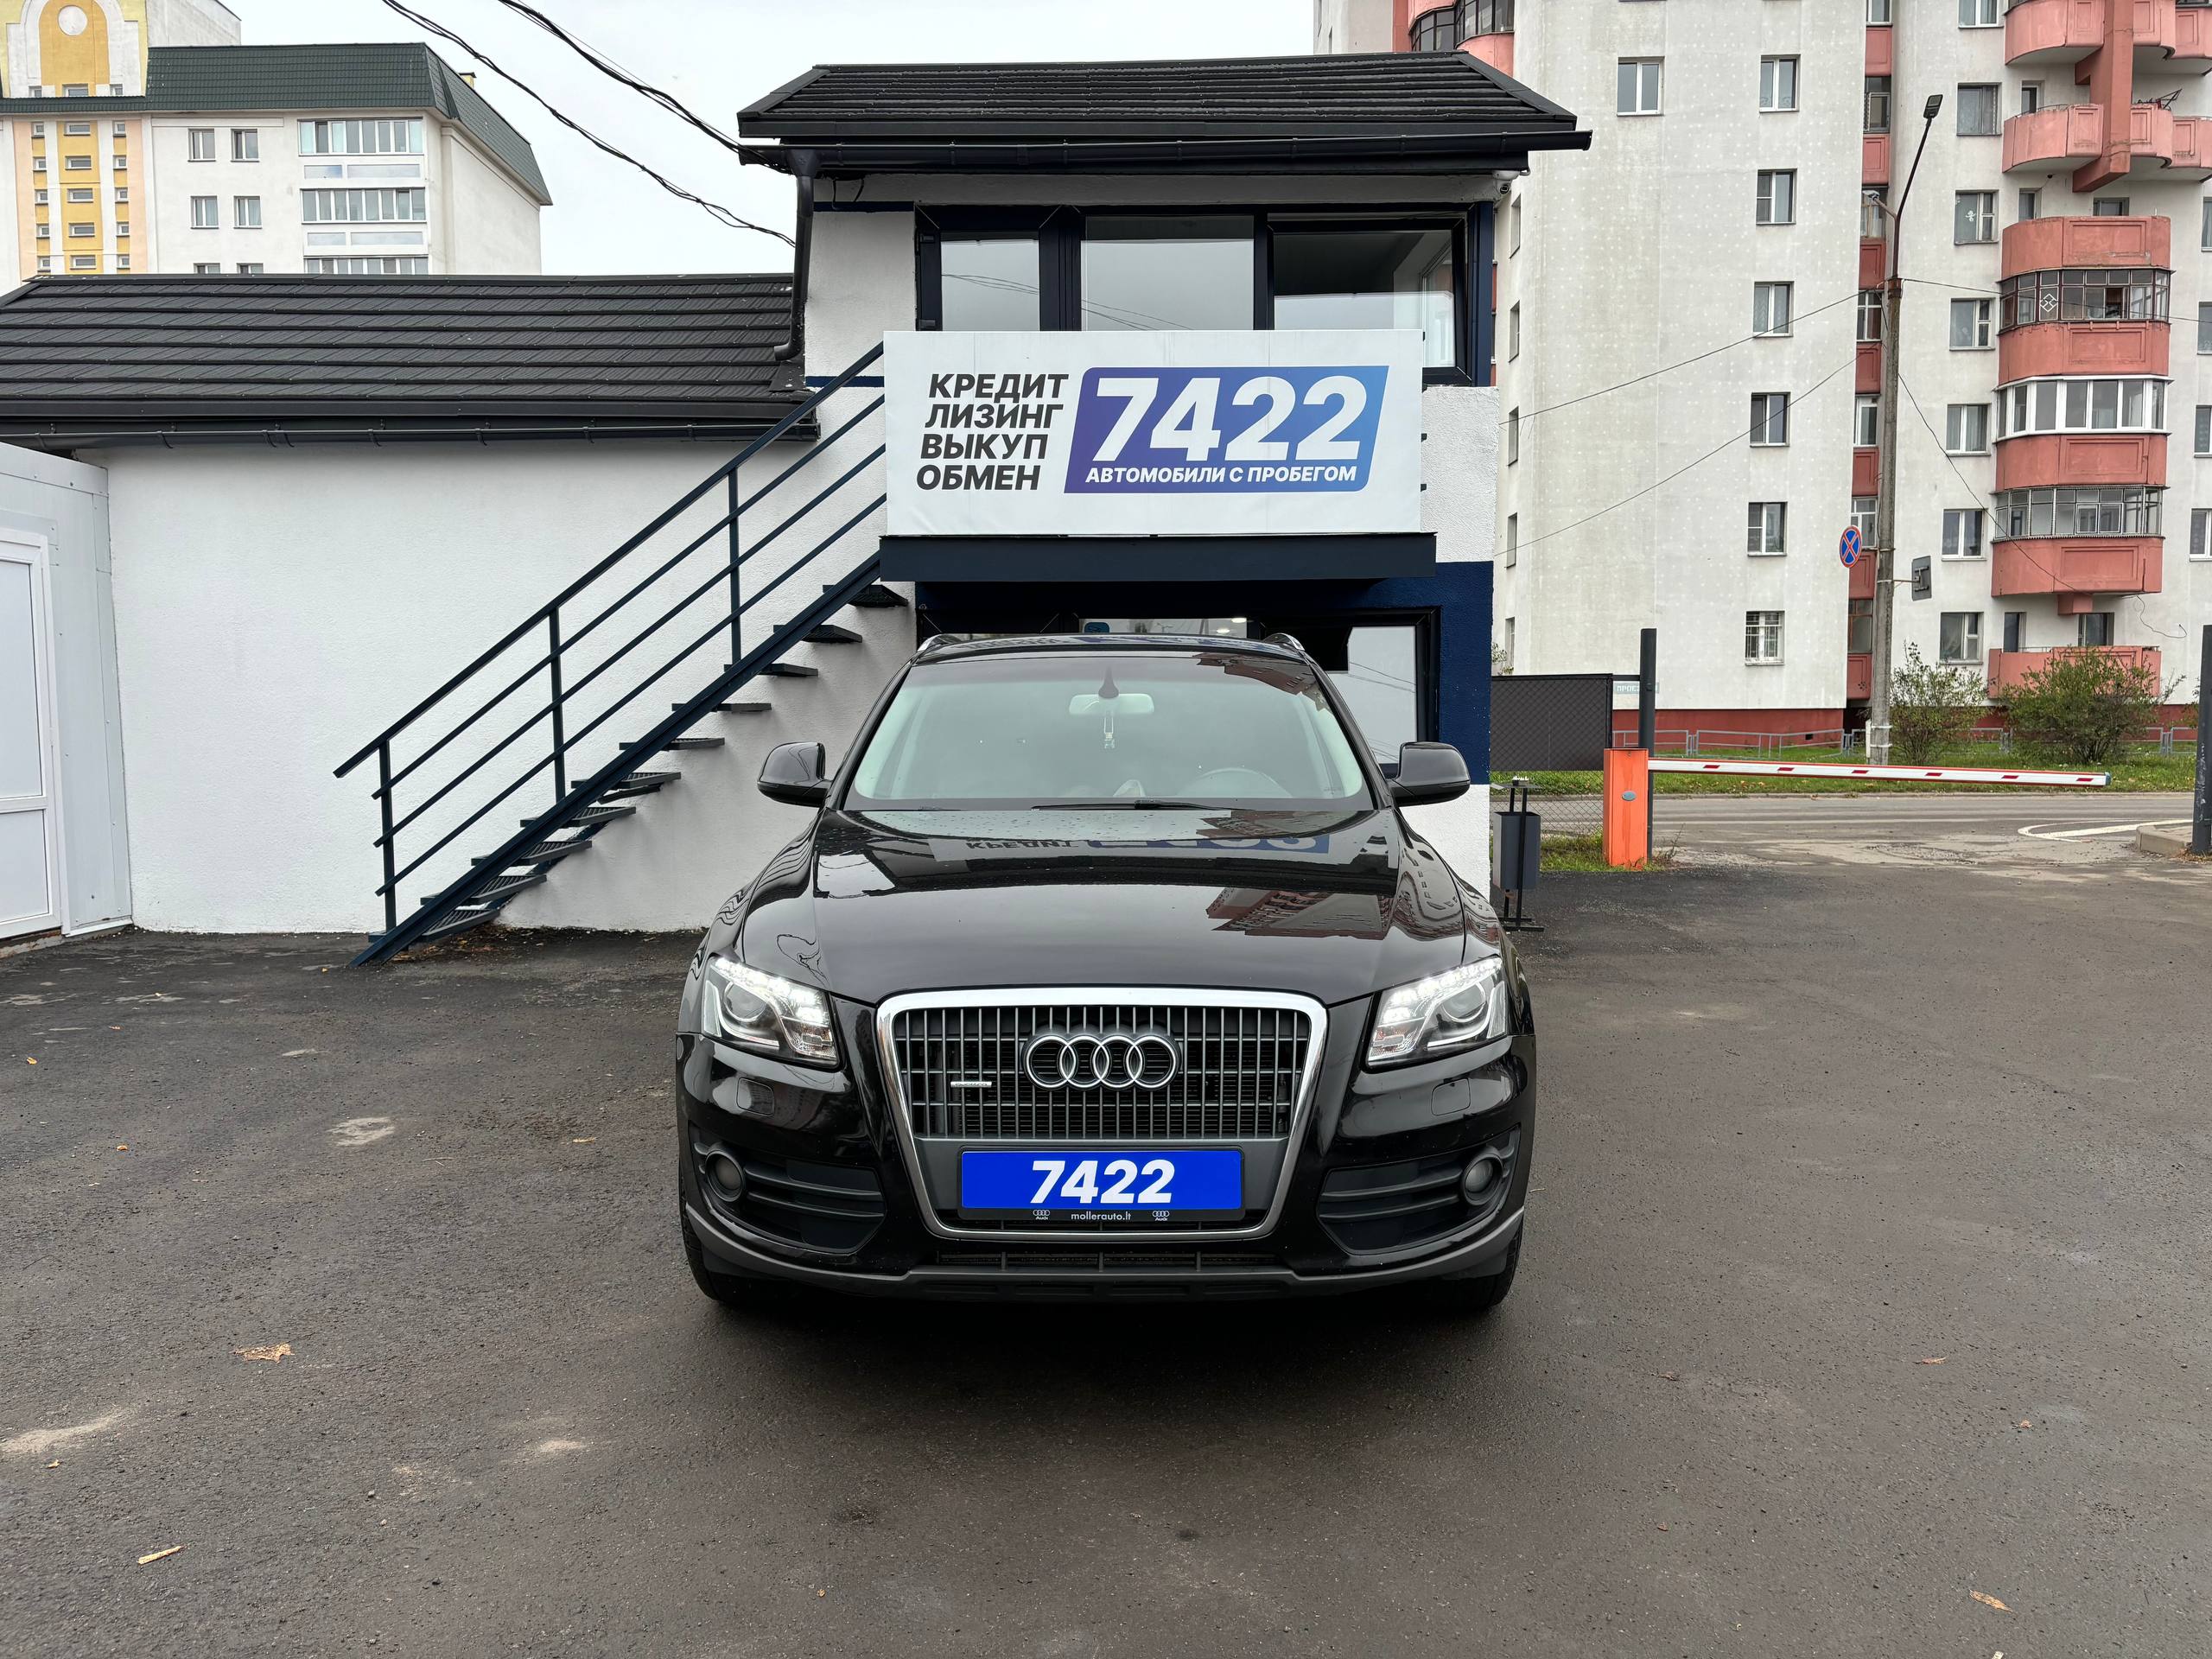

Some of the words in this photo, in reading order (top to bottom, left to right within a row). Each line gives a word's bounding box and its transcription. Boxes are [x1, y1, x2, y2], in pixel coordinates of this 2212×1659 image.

[929, 373, 1069, 404] КРЕДИТ
[925, 404, 1064, 429] ЛИЗИНГ
[1092, 376, 1367, 461] 7422
[920, 433, 1049, 460] ВЫКУП
[916, 464, 1041, 491] ОБМЕН
[1084, 467, 1226, 483] АВТОМОБИЛИ
[1229, 467, 1243, 483] С
[1247, 466, 1357, 482] ПРОБЕГОМ
[1030, 1159, 1175, 1204] 7422
[1071, 1211, 1132, 1221] mollerauto.lt
